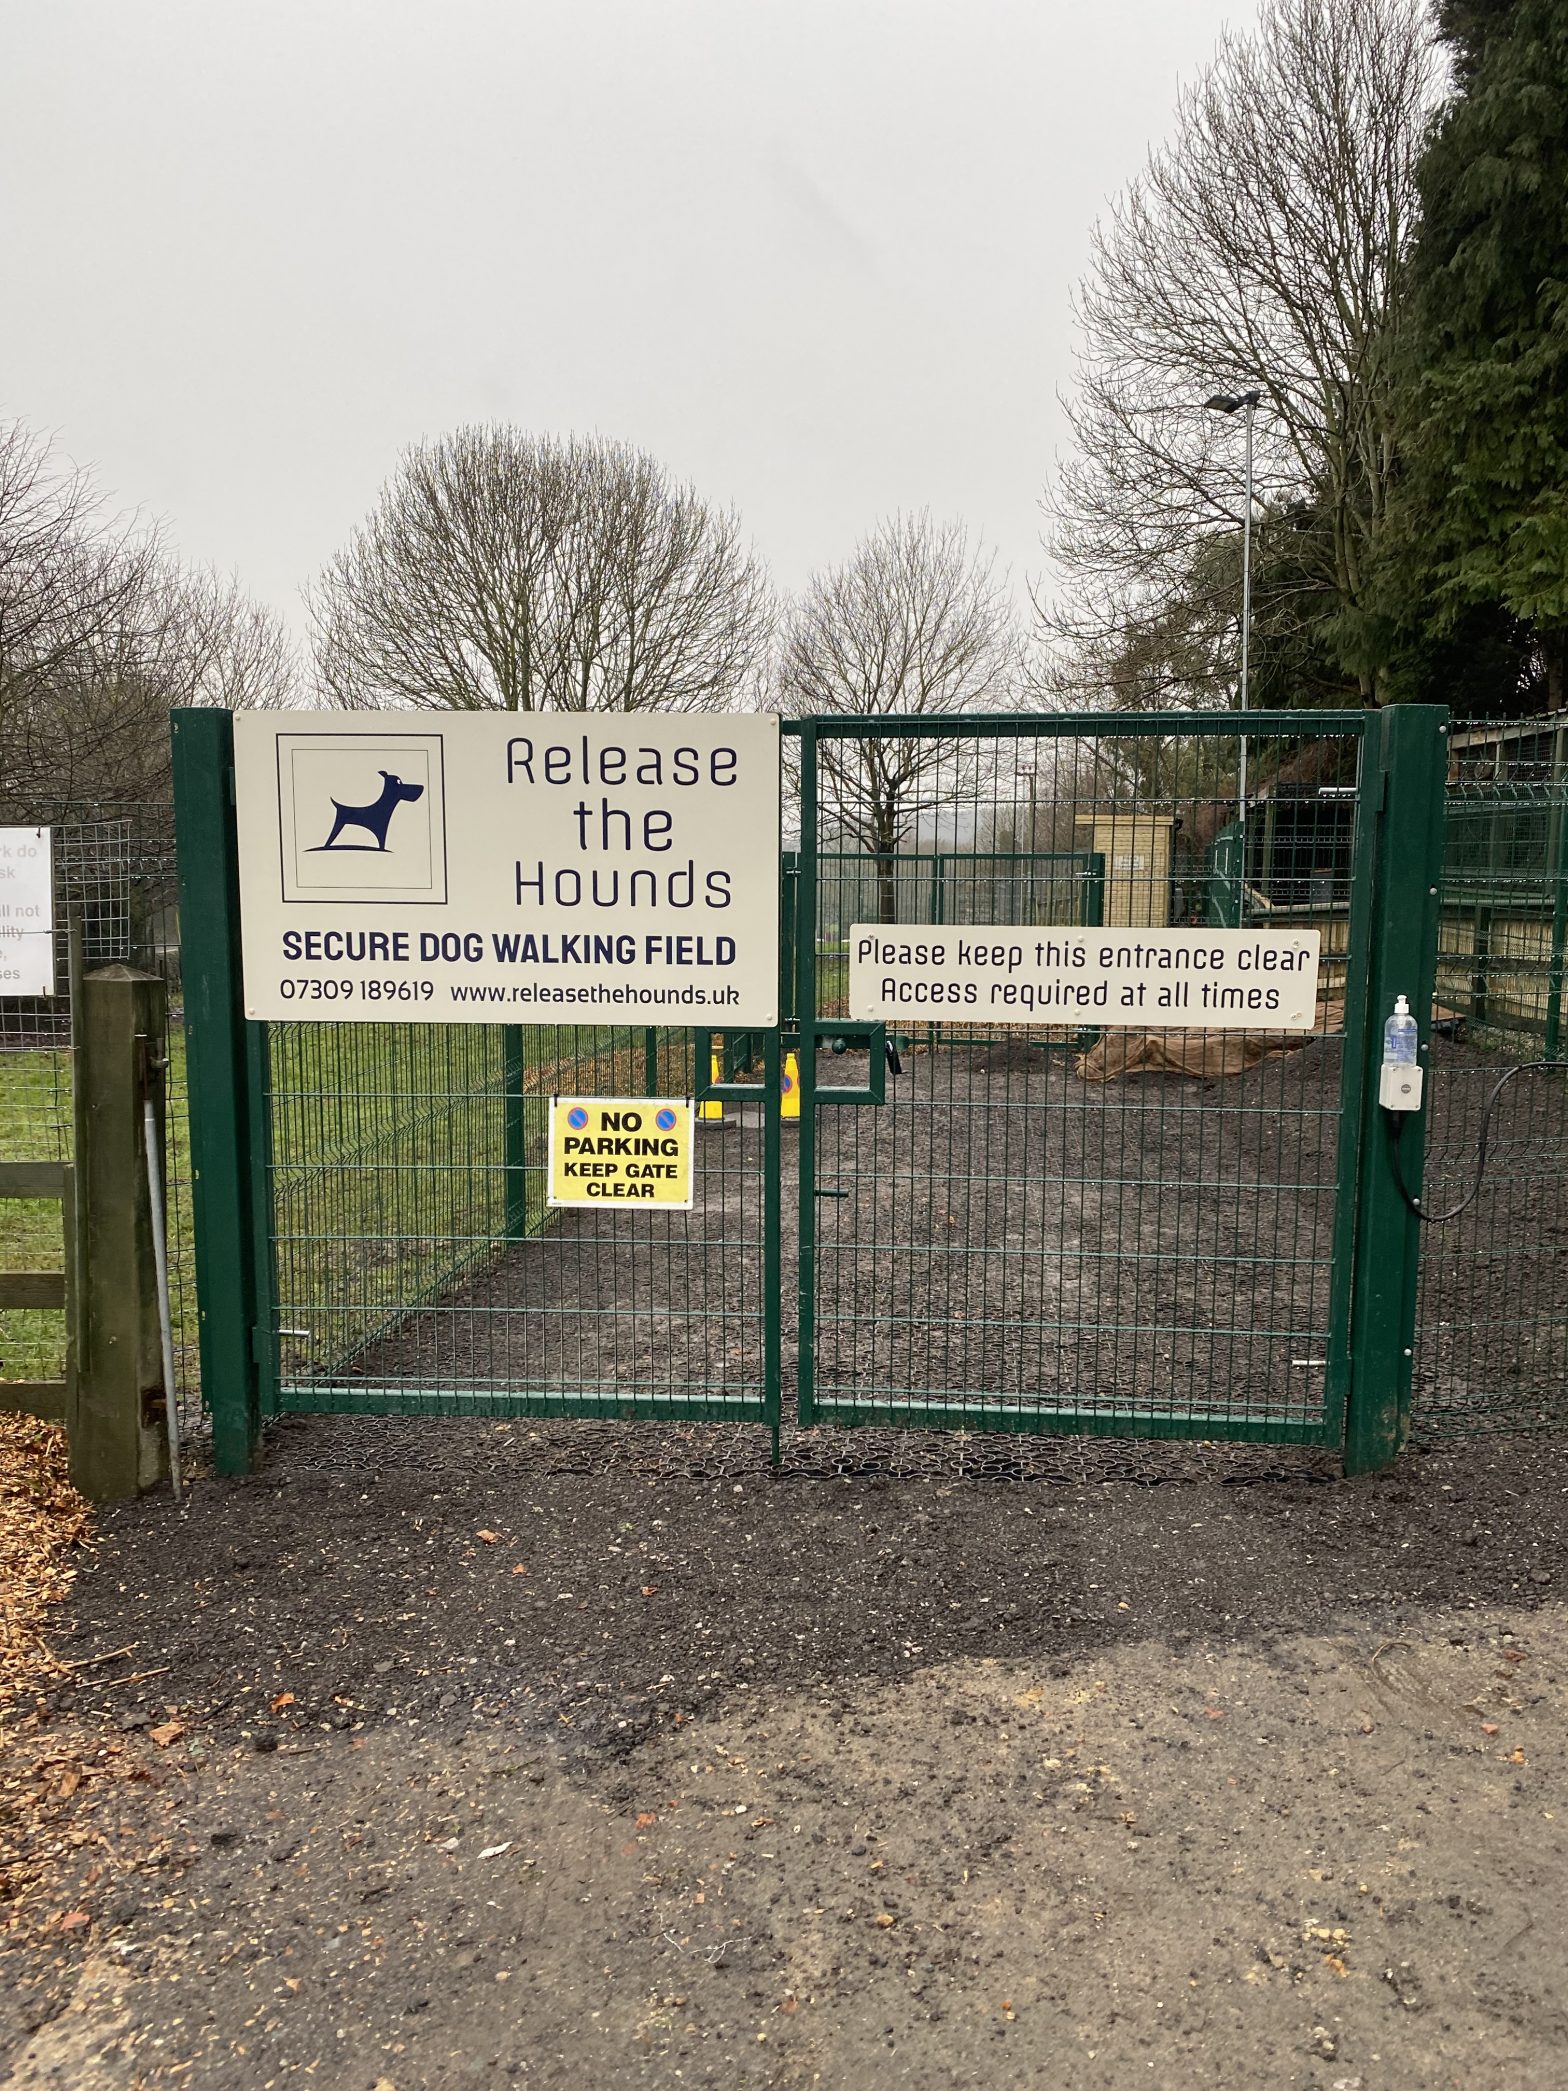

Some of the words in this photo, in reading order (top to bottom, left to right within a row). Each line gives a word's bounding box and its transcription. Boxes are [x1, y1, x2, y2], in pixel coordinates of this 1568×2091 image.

[506, 735, 737, 787] Release
[573, 797, 673, 852] the
[16, 843, 38, 859] do
[515, 859, 731, 909] Hounds
[15, 903, 40, 918] not
[282, 930, 410, 962] SECURE
[420, 932, 483, 963] DOG
[491, 933, 636, 965] WALKING
[645, 935, 736, 966] FIELD
[858, 939, 945, 966] Please
[958, 939, 1023, 974] keep
[1034, 941, 1086, 968] this
[1099, 943, 1225, 970] entrance
[1237, 944, 1310, 972] clear
[280, 979, 354, 1000] 07309
[359, 980, 434, 1001] 189619
[450, 982, 740, 1005] www.releasethehounds.uk
[881, 977, 978, 1004] Access
[990, 978, 1108, 1012] required
[1120, 982, 1147, 1007] at
[1157, 981, 1189, 1008] all
[1201, 981, 1280, 1010] times
[602, 1112, 642, 1132] NO
[564, 1136, 679, 1157] PARKING
[564, 1162, 618, 1178] KEEP
[625, 1163, 678, 1179] GATE
[586, 1182, 655, 1198] CLEAR
